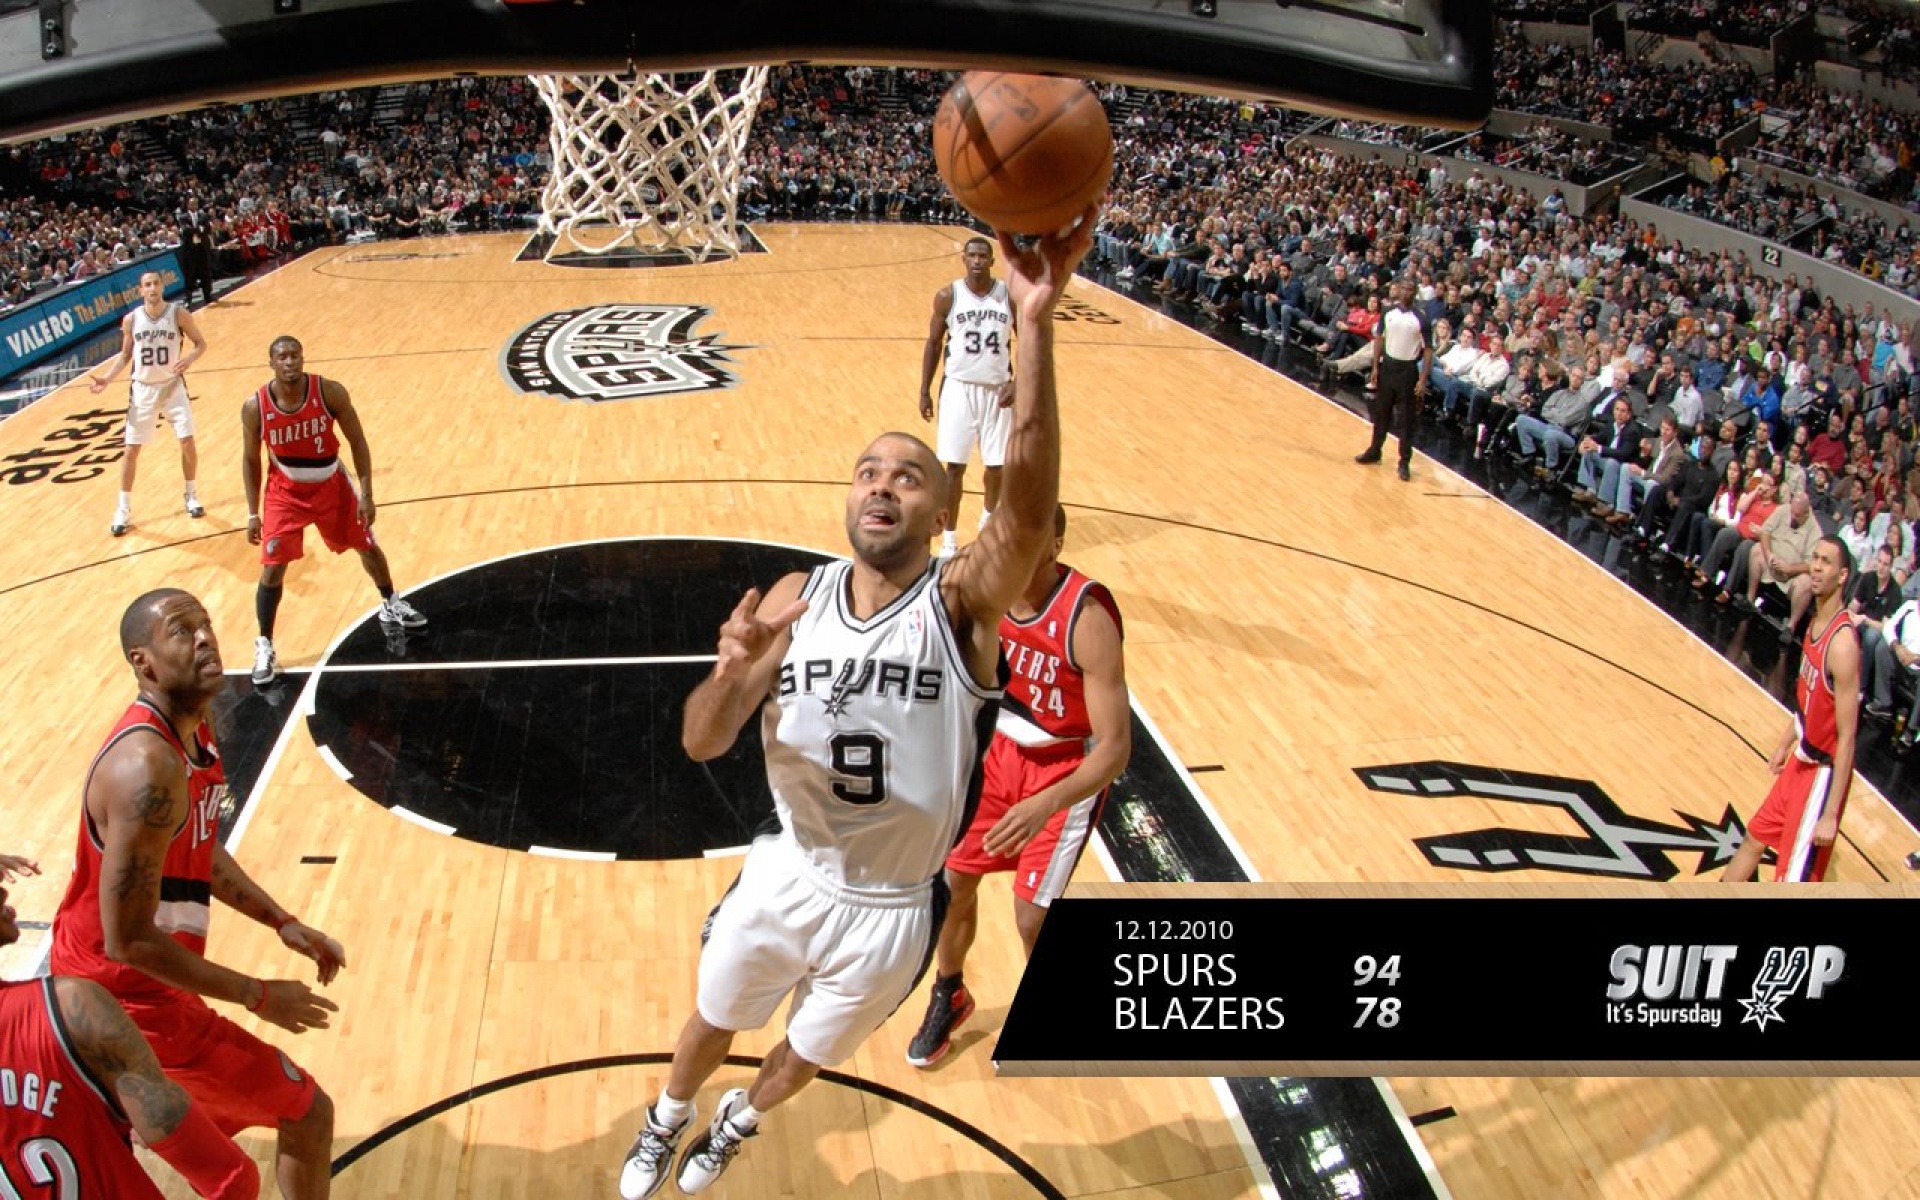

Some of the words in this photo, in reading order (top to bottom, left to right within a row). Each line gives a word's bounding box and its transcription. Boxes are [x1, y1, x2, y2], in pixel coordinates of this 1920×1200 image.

[1764, 247, 1779, 265] 22
[6, 310, 75, 358] VALERO
[74, 303, 95, 325] The
[956, 309, 1009, 326] SPURS
[134, 330, 175, 342] SPURS
[518, 314, 573, 358] ANTONIO
[565, 307, 684, 391] SPURS
[965, 331, 1000, 355] 34
[141, 346, 169, 366] 20
[518, 361, 553, 388] SAN
[269, 415, 327, 446] BLAZERS
[314, 435, 325, 454] 2
[780, 658, 943, 703] SPURS
[1029, 684, 1066, 718] 24
[828, 732, 889, 806] 9
